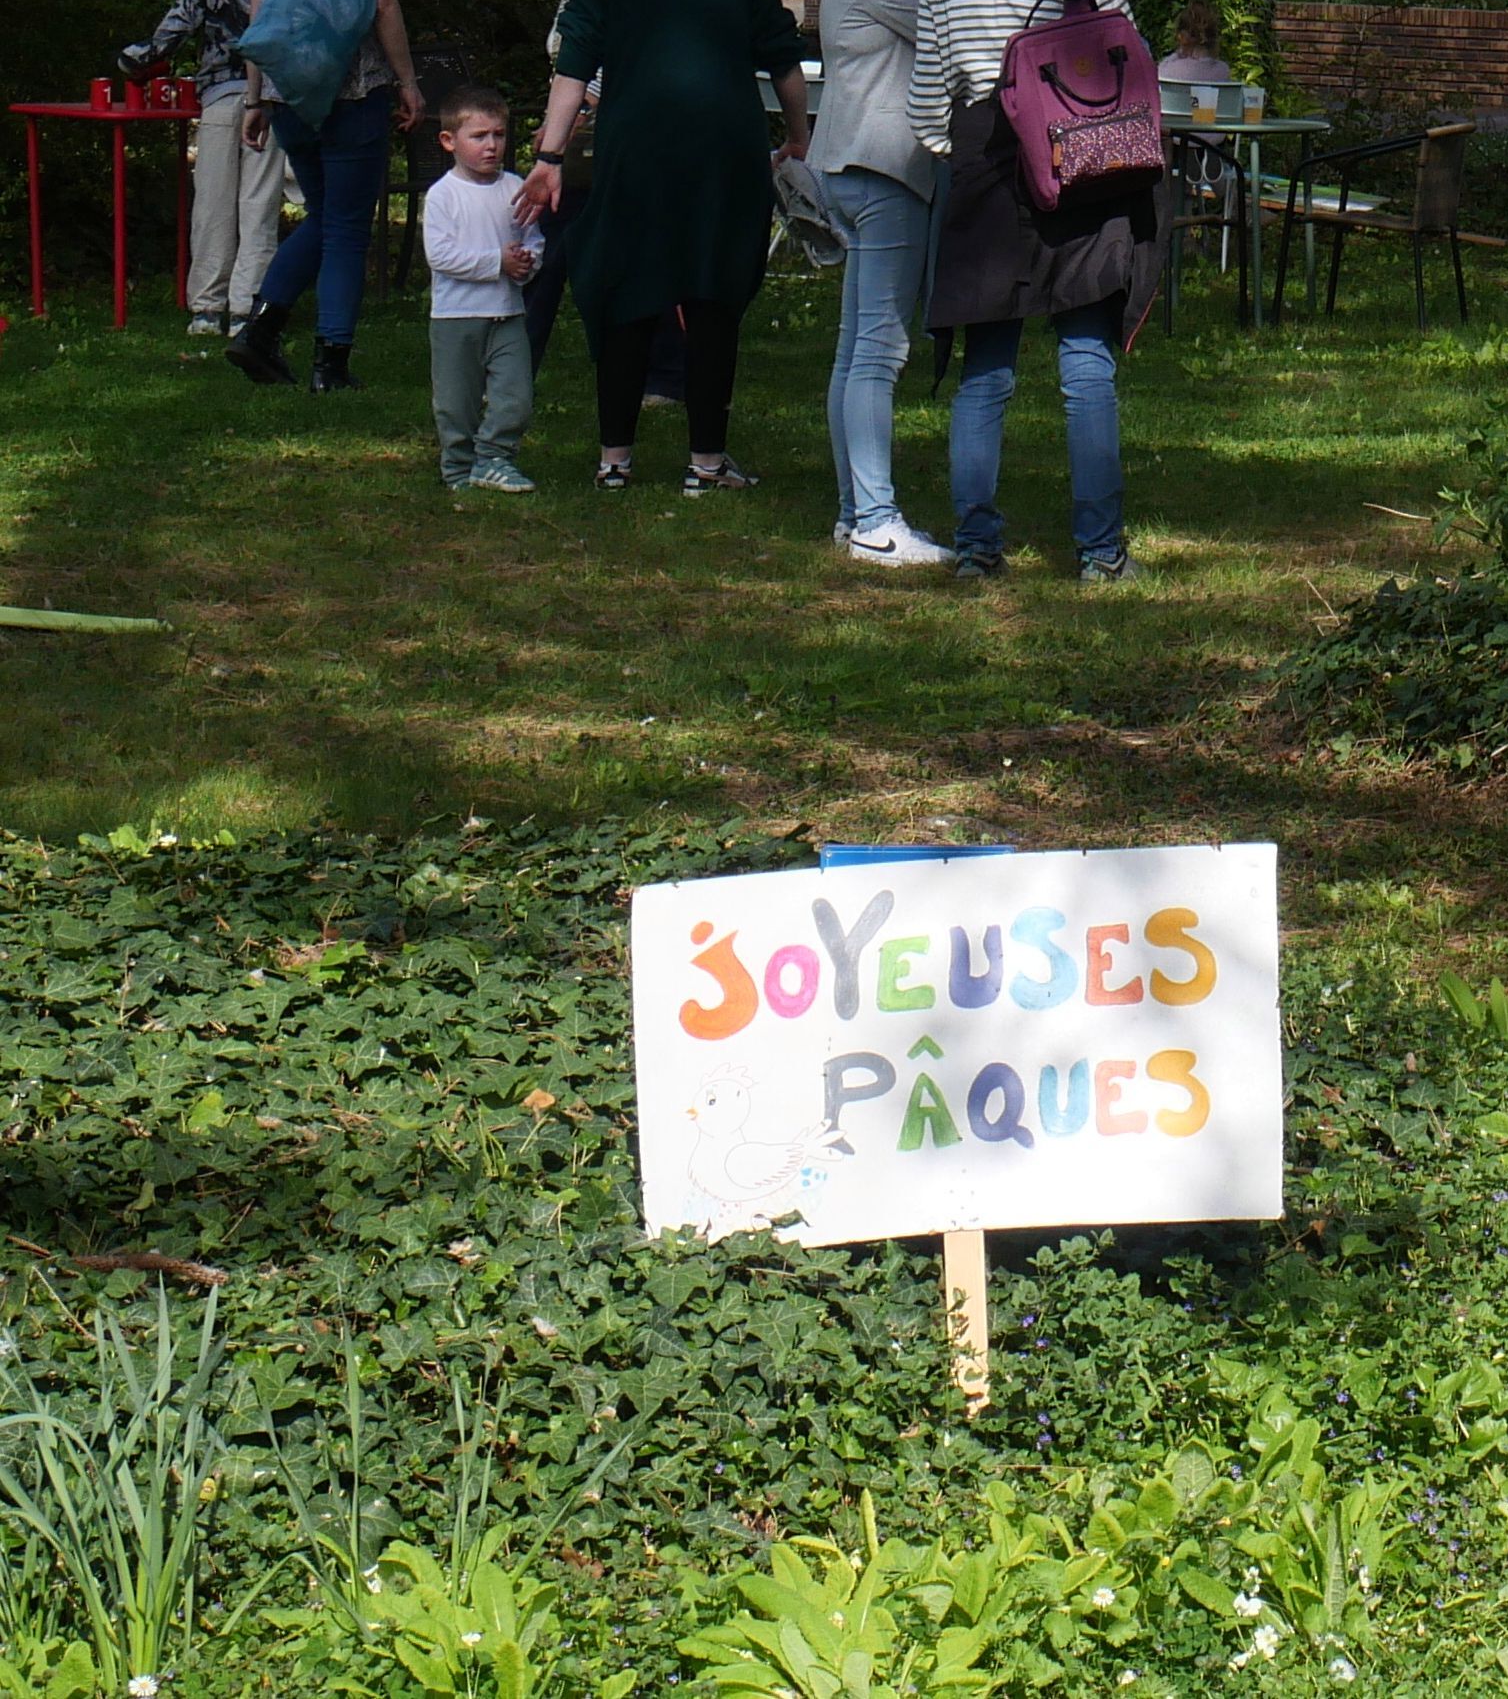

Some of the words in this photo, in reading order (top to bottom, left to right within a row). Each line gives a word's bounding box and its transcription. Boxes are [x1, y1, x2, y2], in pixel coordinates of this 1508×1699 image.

[103, 86, 111, 103] 1
[160, 84, 170, 102] 3
[823, 1034, 1211, 1155] PÂQUES
